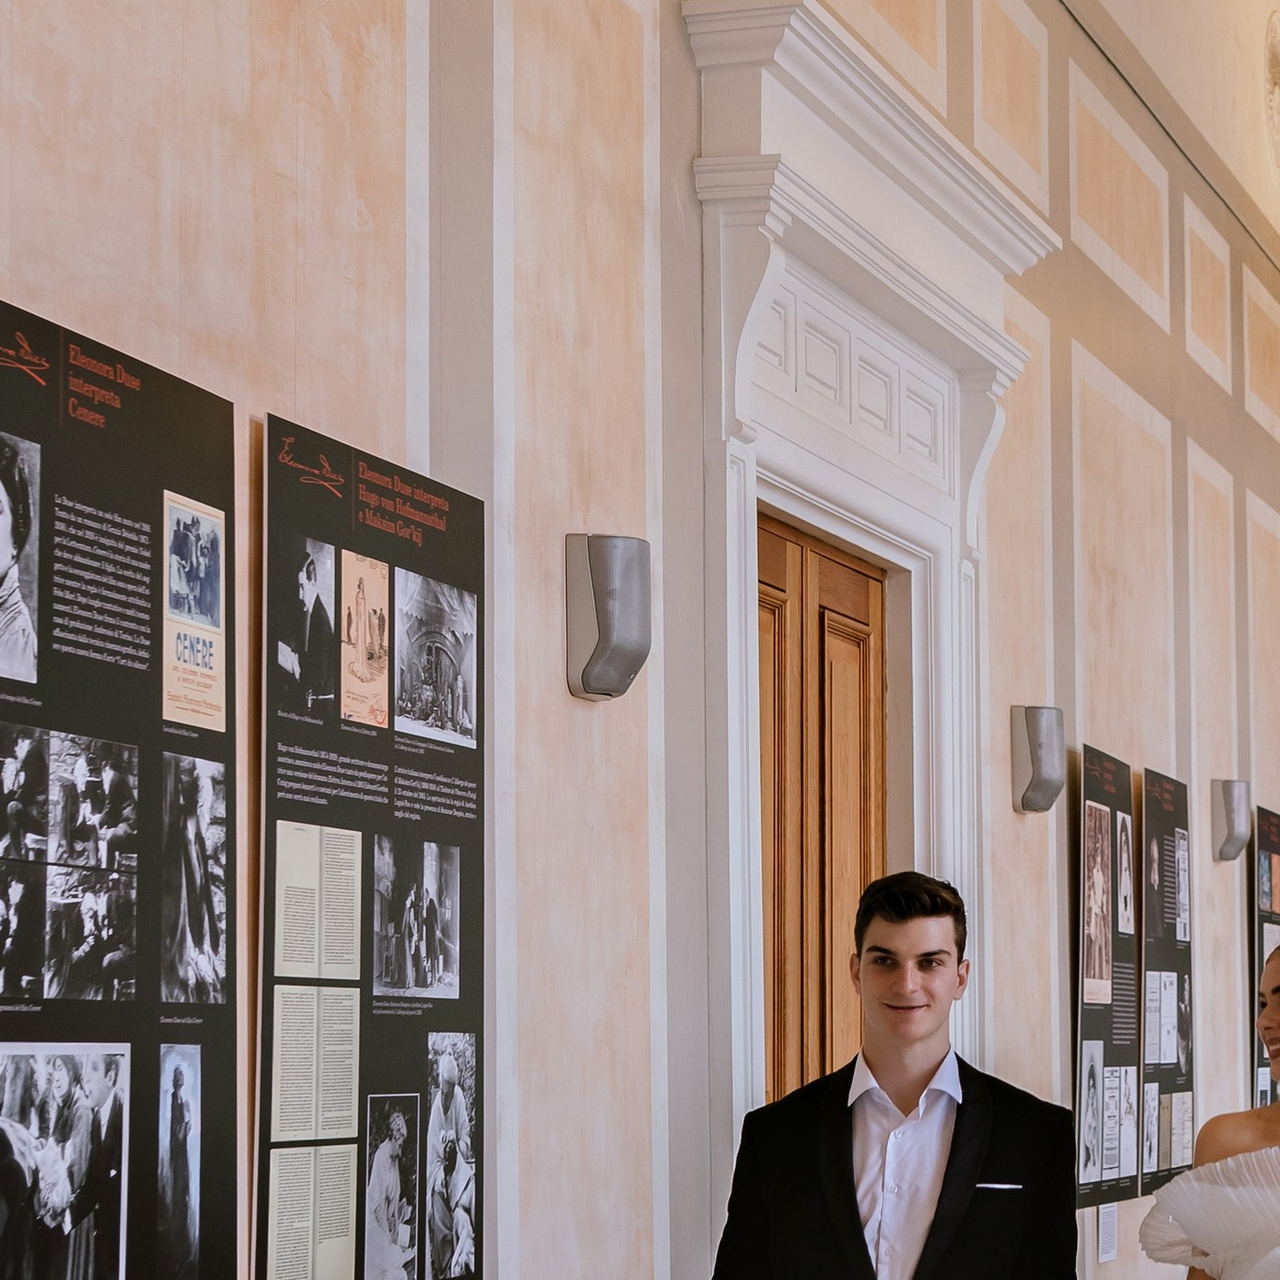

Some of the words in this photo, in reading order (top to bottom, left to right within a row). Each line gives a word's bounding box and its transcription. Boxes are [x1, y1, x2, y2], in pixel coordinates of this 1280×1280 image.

[68, 343, 114, 379] Eleonora
[116, 363, 140, 390] Duse
[68, 370, 121, 408] interpreta
[68, 397, 105, 428] Cenere
[358, 460, 392, 489] Eleonora
[394, 474, 412, 497] Duse
[412, 483, 450, 511] interpreta
[358, 483, 380, 508] Hugo
[381, 495, 395, 512] von
[395, 497, 446, 531] Hofmannsthal
[364, 507, 395, 533] Maksim
[176, 632, 214, 670] CENERE
